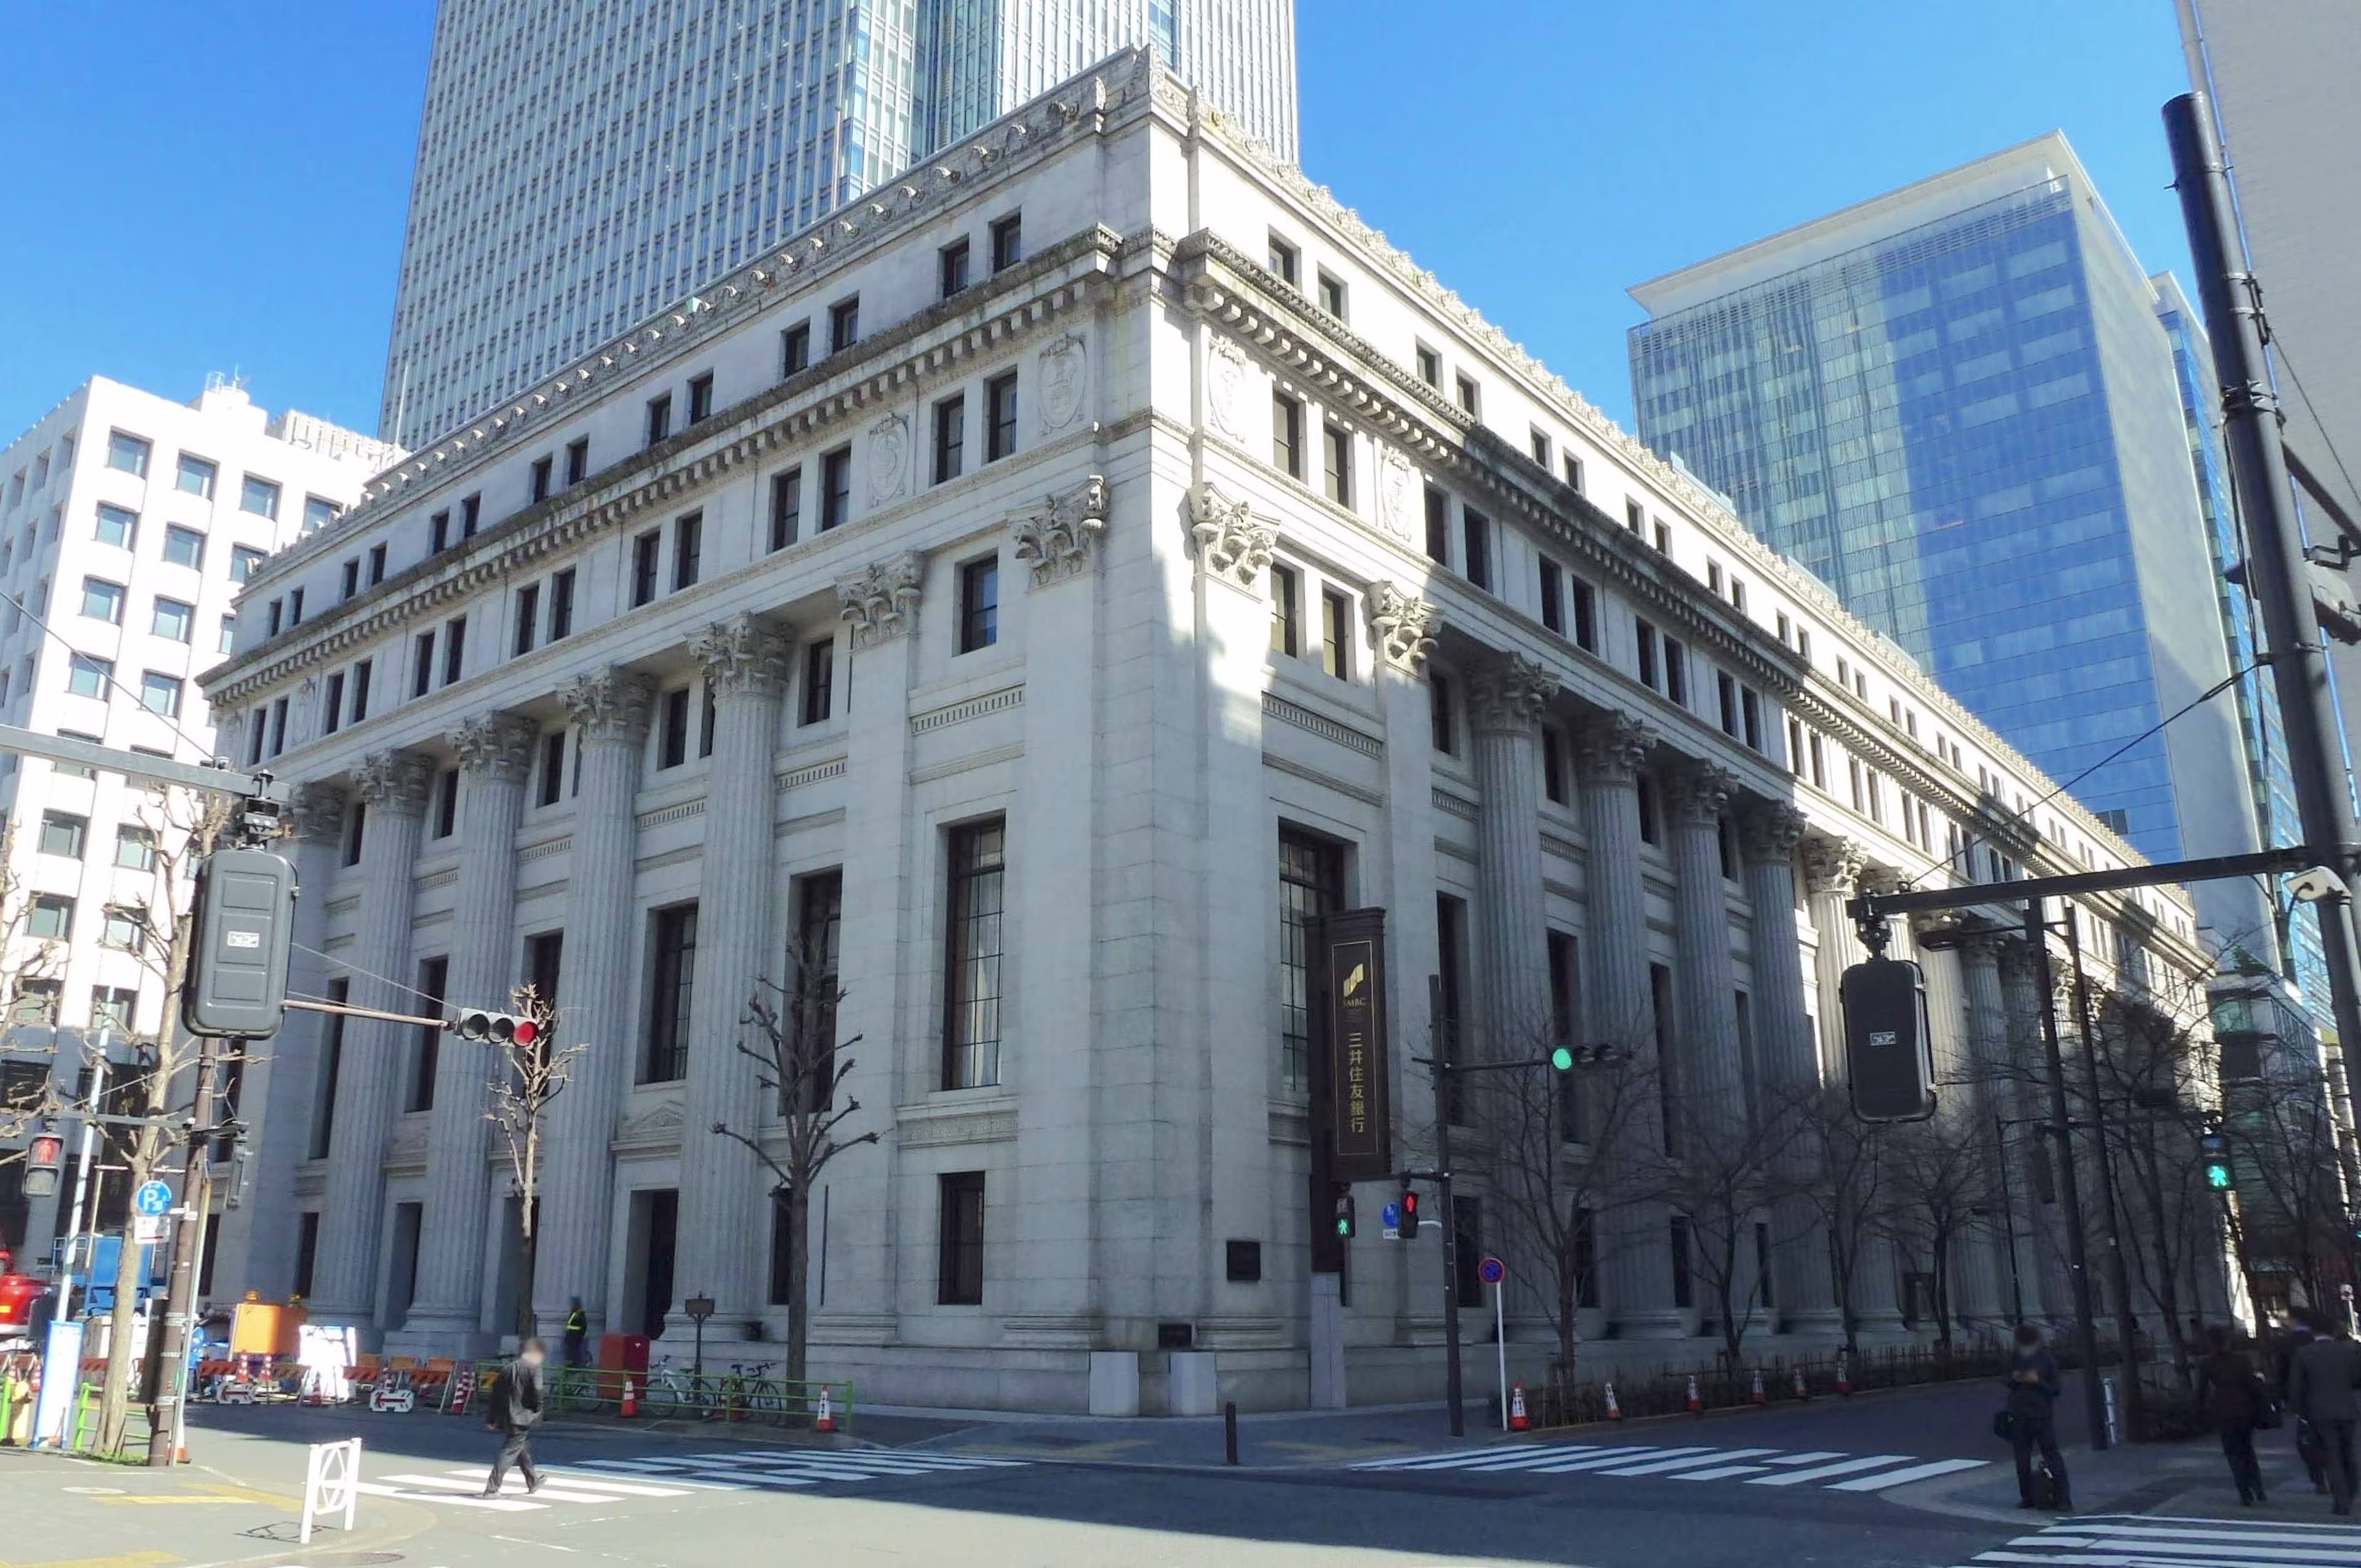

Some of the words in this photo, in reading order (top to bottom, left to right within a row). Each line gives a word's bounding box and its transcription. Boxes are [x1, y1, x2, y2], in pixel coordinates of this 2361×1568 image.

[1342, 997, 1366, 1007] SMBC
[1348, 1032, 1364, 1133] 三井住友銀行
[143, 1189, 158, 1211] P
